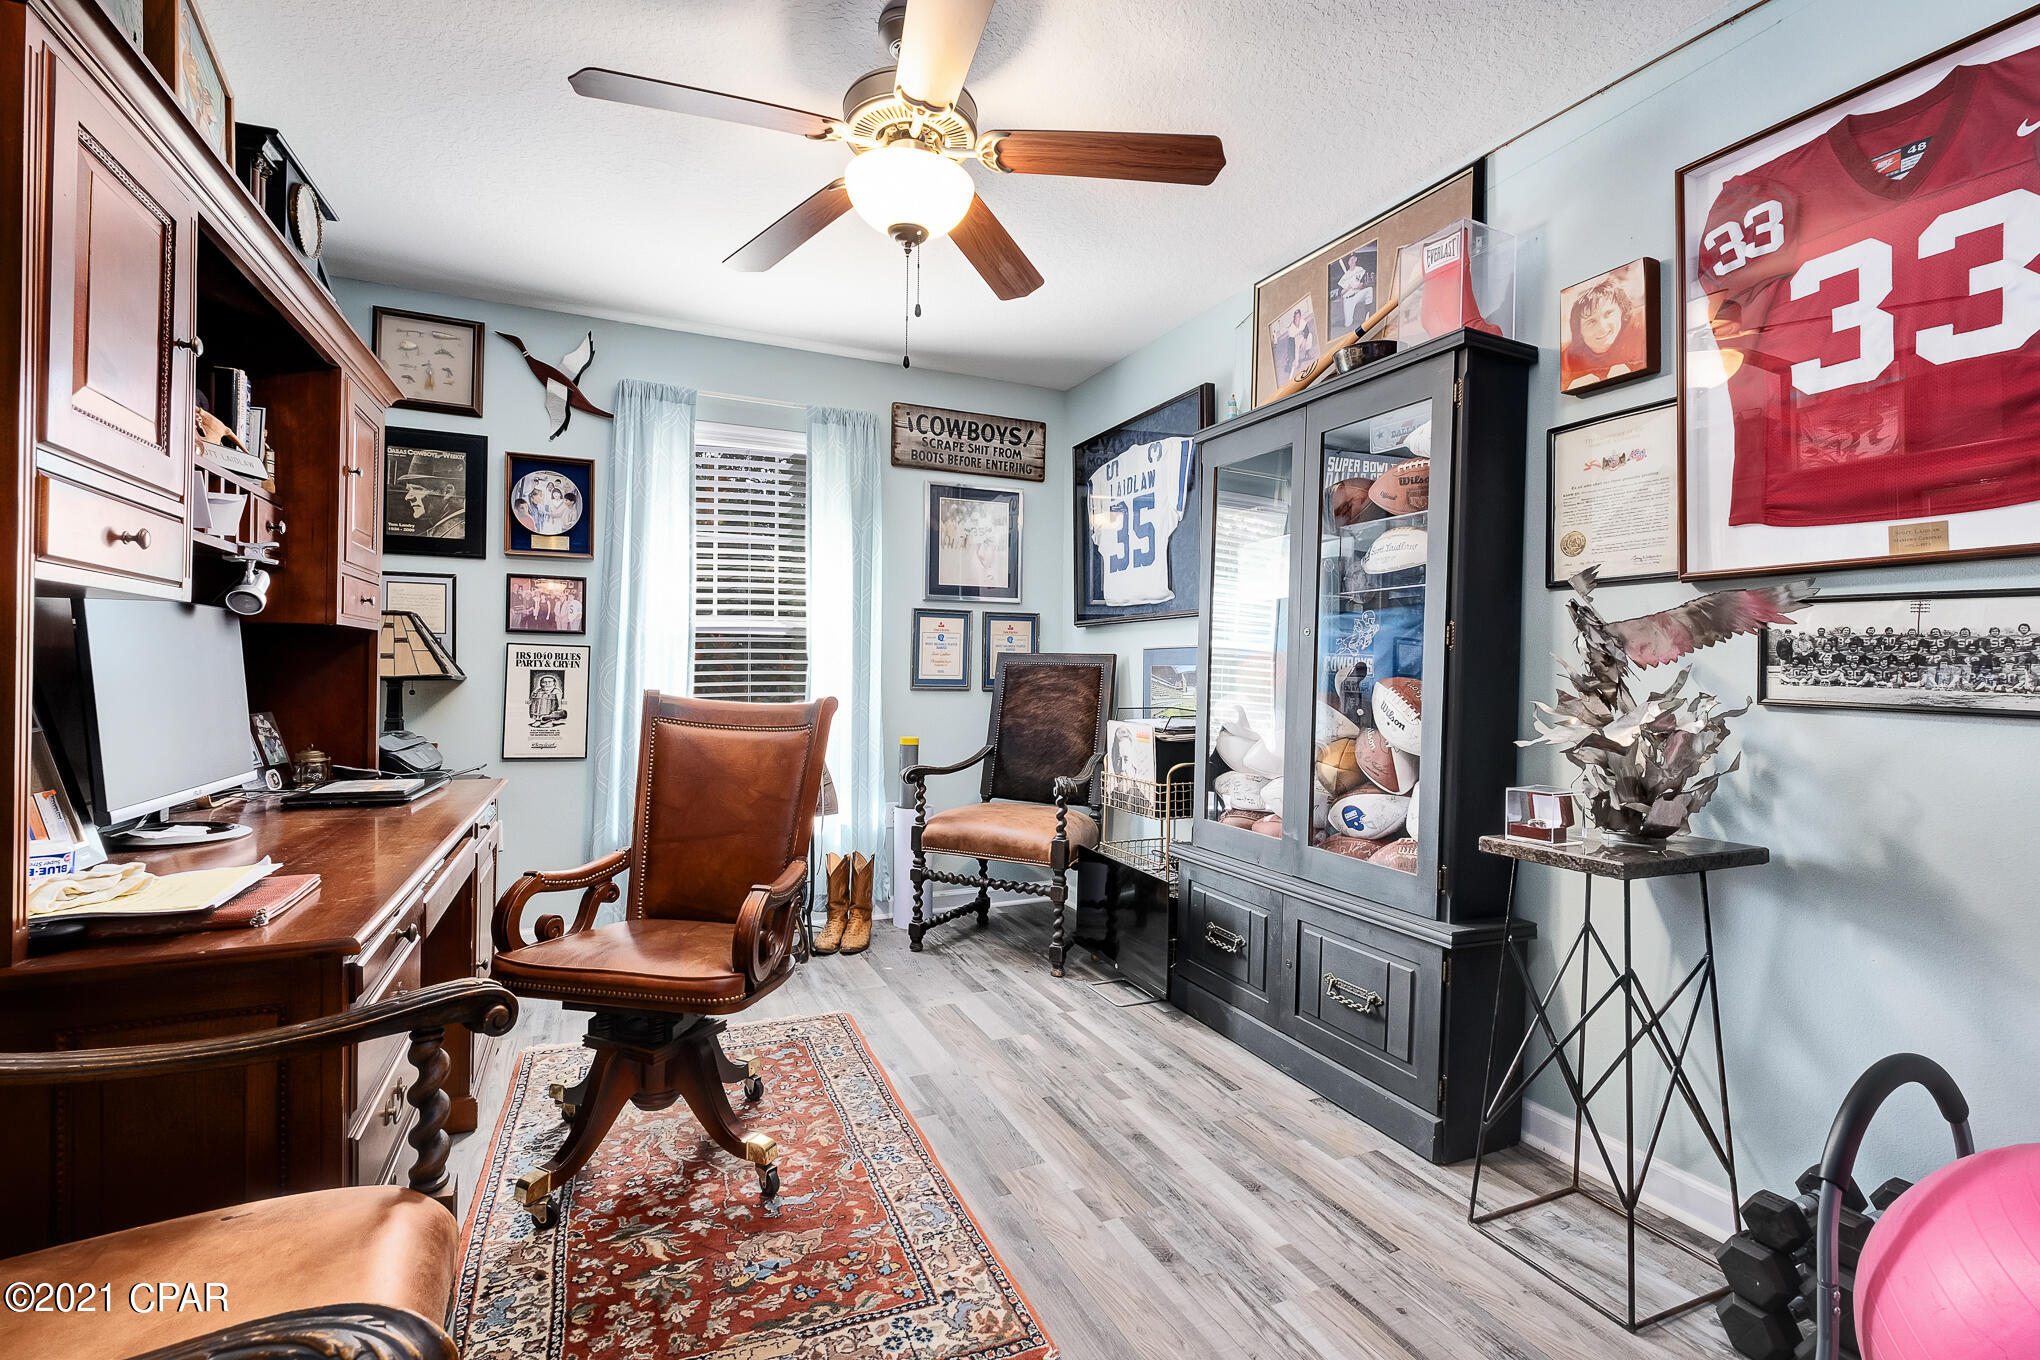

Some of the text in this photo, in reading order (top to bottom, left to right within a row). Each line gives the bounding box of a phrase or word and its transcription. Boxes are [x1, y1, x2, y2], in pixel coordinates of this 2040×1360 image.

[1907, 141, 1928, 155] 48
[1704, 199, 1785, 277] 33
[1426, 237, 1458, 268] EVERLAST
[1790, 188, 2040, 396] 33
[906, 412, 1034, 448] ¡COWBOYS!
[921, 437, 1023, 460] SCRAPE SHIT FROM
[911, 449, 1033, 475] BOOTS BEFORE ENTERING
[1327, 457, 1361, 473] SUPER
[1110, 469, 1156, 502] LAIDLAW
[1399, 475, 1430, 486] Wilso
[1110, 493, 1156, 573] 35
[515, 651, 531, 660] IRS
[554, 652, 581, 661] BLUES
[515, 659, 544, 668] PARTY
[544, 660, 551, 668] &
[1323, 655, 1375, 675] COWBS
[1380, 701, 1406, 731] Wilson
